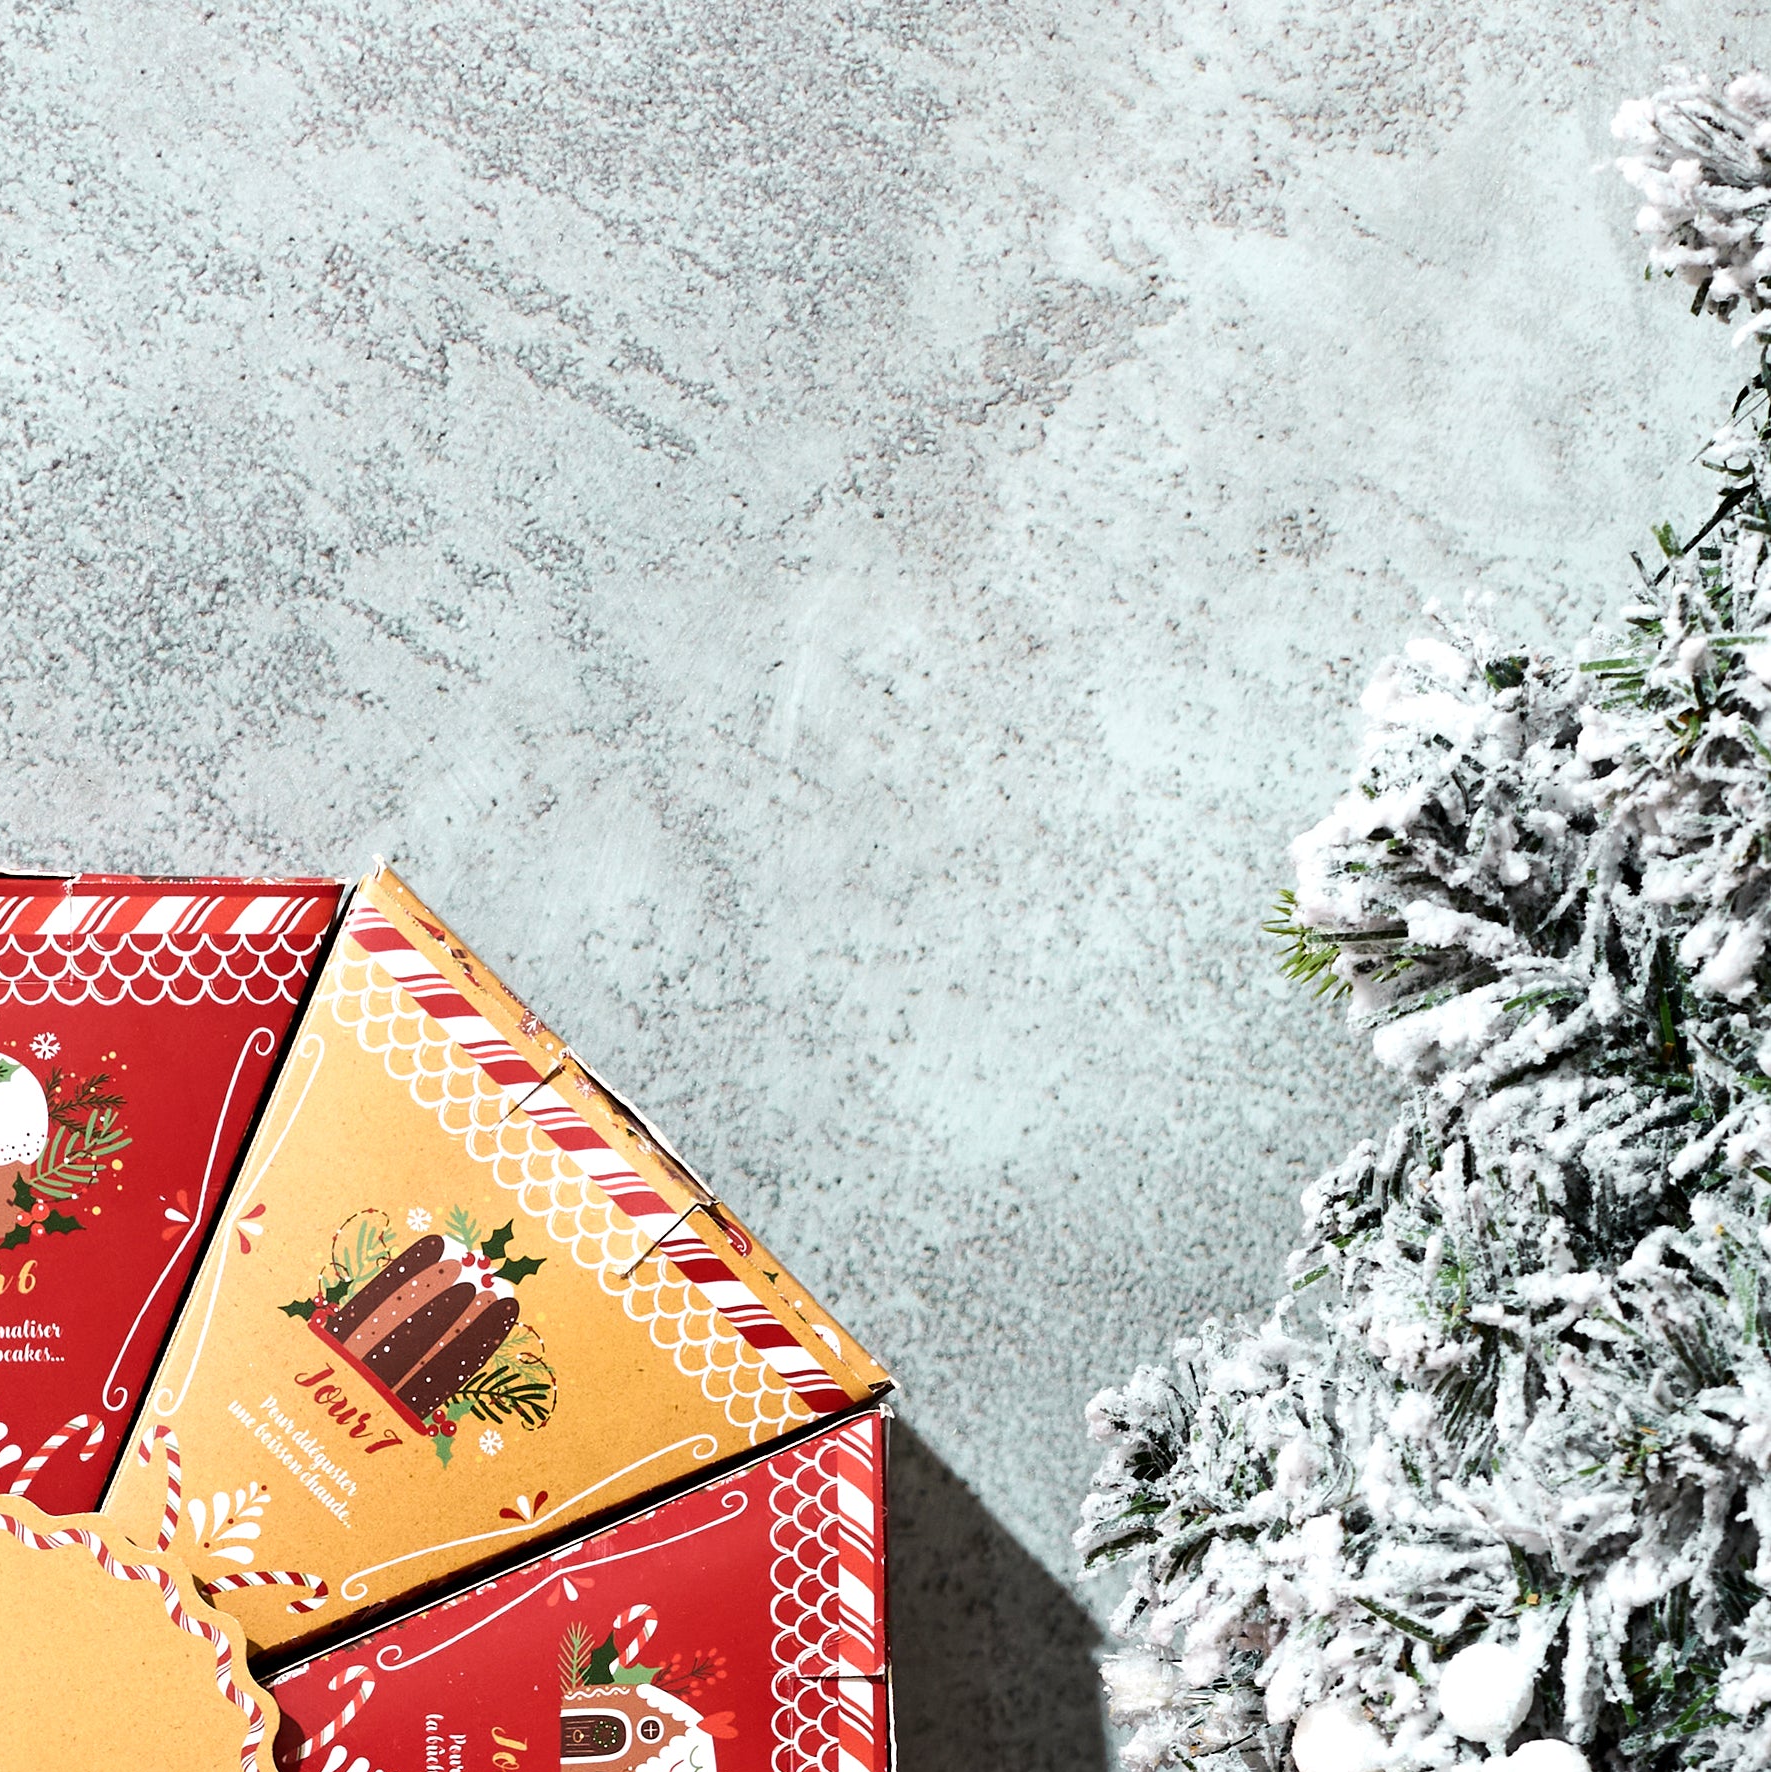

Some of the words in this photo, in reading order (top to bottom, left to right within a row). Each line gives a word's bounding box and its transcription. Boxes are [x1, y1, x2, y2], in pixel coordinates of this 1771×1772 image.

[18, 1259, 38, 1294] 6
[228, 1400, 256, 1429] une
[254, 1423, 303, 1474] boisson
[294, 1362, 373, 1438] Jour
[364, 1429, 403, 1454] 7
[260, 1395, 294, 1434] Pour
[292, 1429, 358, 1496] ddéguster
[426, 1714, 444, 1734] la
